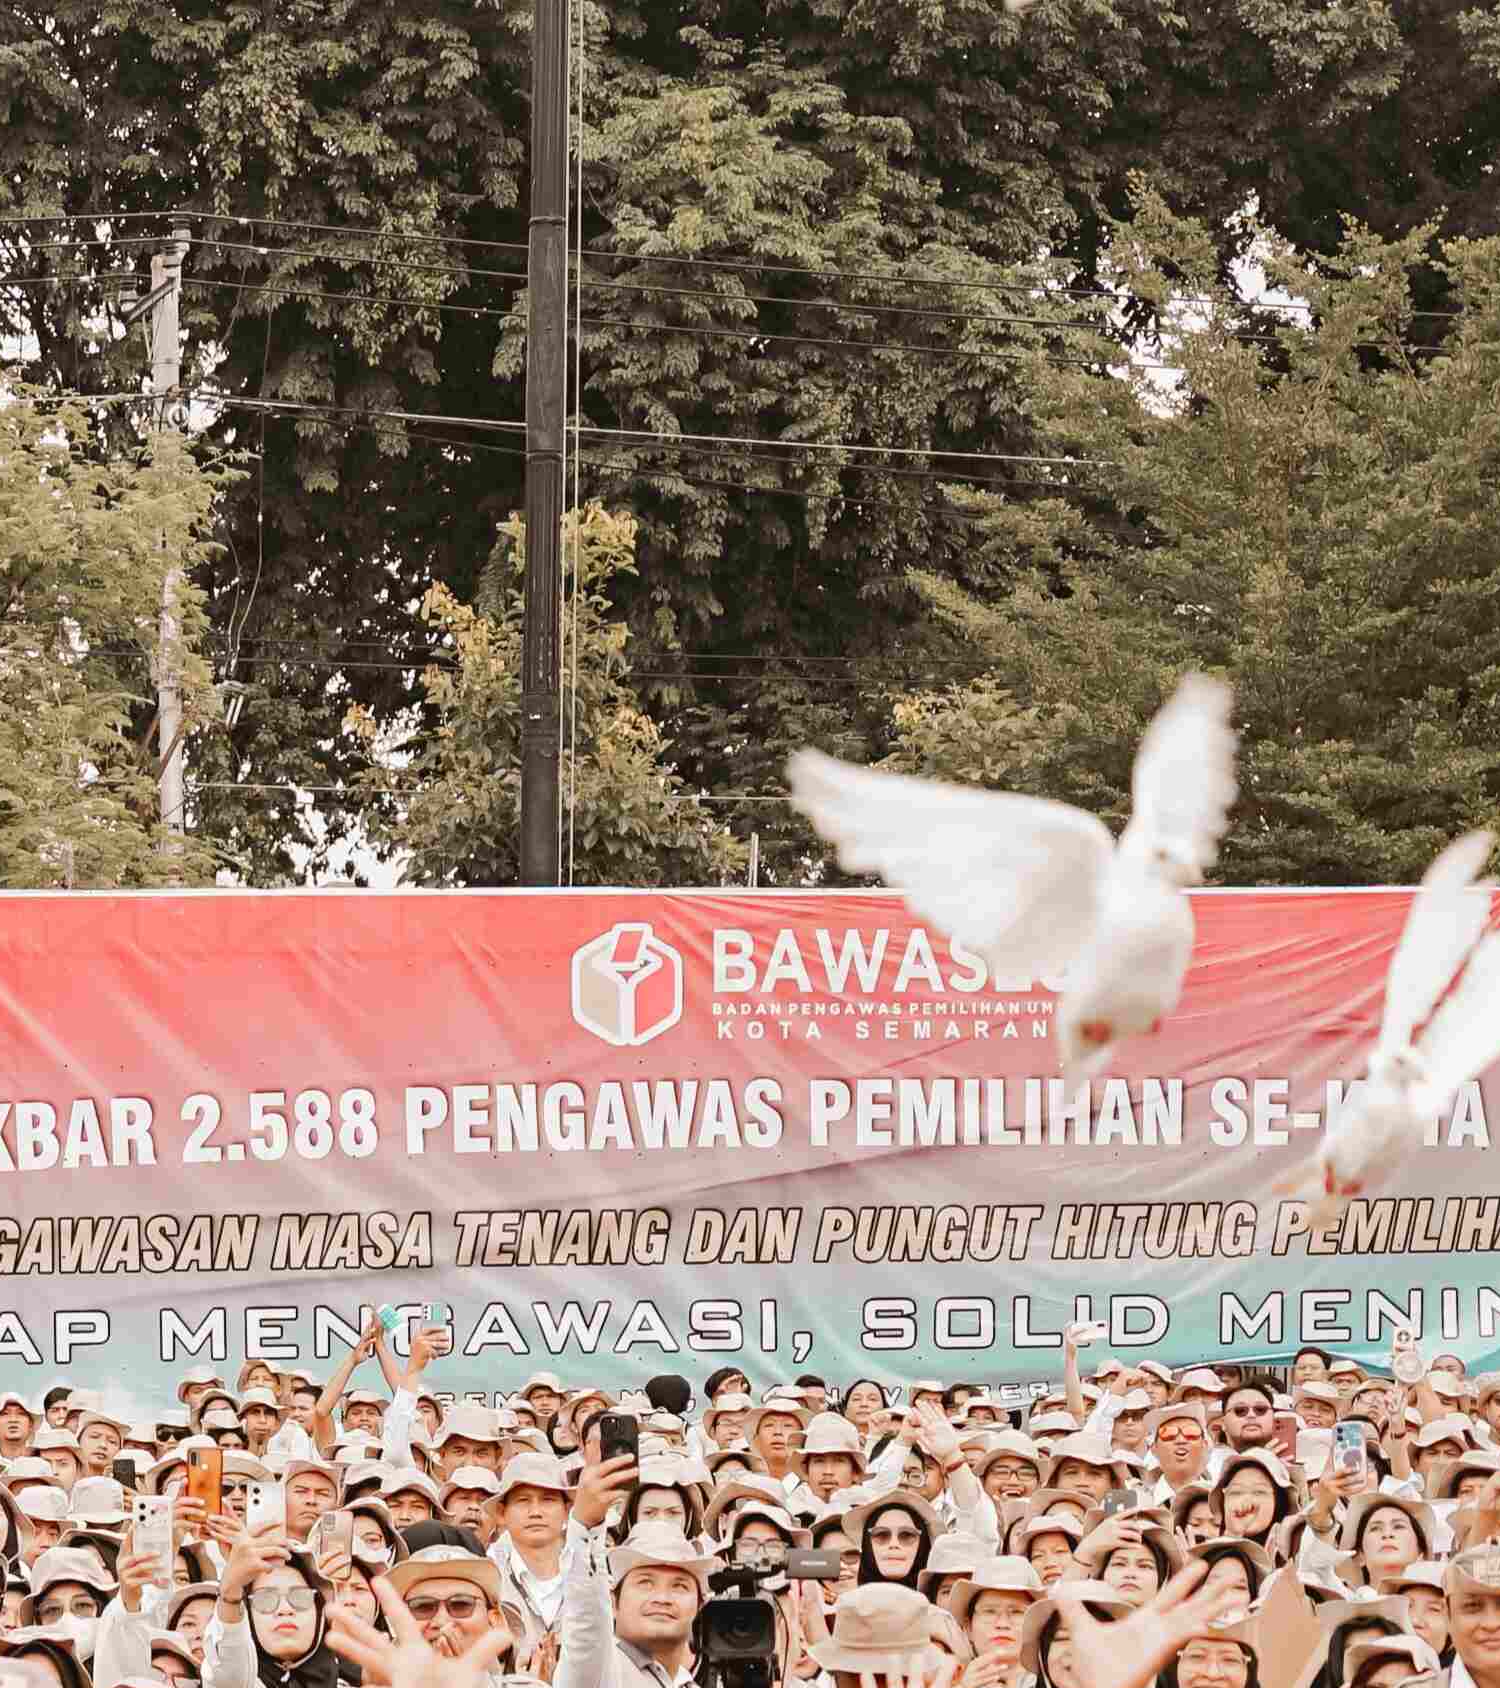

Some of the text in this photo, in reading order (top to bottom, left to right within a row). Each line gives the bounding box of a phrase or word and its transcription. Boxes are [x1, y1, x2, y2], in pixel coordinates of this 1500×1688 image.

[712, 928, 1068, 994] BAWAS
[711, 1001, 782, 1016] BADAN
[787, 1001, 903, 1016] PENGAWAS
[908, 1001, 1021, 1015] PEMILIHAN
[716, 1020, 1049, 1040] KOTA SEMARAN
[179, 1087, 380, 1163] 2.588
[404, 1077, 784, 1156] PENGAWAS
[810, 1076, 1184, 1149] PEMILIHAN
[270, 1211, 434, 1271] MASA
[453, 1207, 672, 1268] TENANG
[683, 1205, 803, 1265] DAN
[812, 1202, 1045, 1265] PUNGUT
[1050, 1199, 1258, 1261] HITUNG
[859, 1292, 1172, 1351] SOLID
